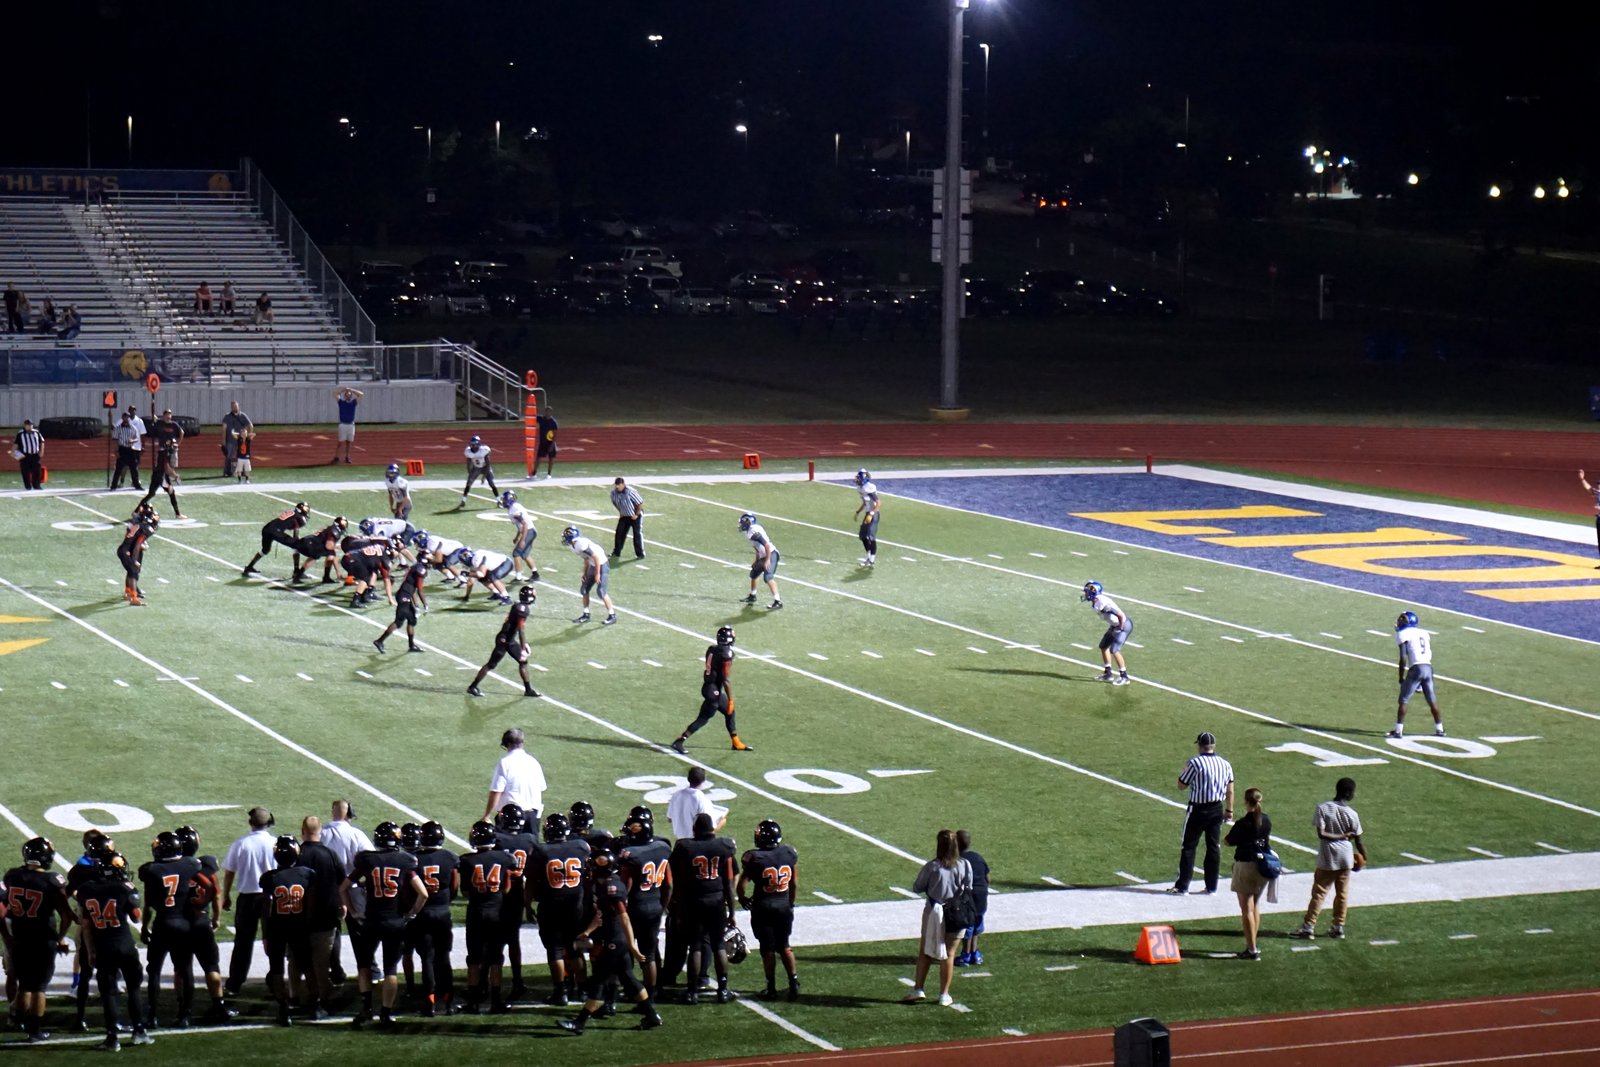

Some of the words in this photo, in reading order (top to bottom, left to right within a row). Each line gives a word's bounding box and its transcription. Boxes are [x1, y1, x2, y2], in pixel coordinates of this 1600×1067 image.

[0, 174, 119, 191] HLETICS
[105, 391, 115, 406] 4
[410, 461, 422, 474] 10
[748, 455, 758, 467] G
[1068, 505, 1600, 602] LIO
[1418, 636, 1427, 655] 9
[1265, 735, 1497, 767] 10
[371, 866, 400, 898] 15
[471, 863, 501, 893] 44
[546, 857, 582, 889] 66
[640, 859, 669, 891] 34
[692, 855, 720, 879] 31
[762, 864, 792, 893] 32
[8, 886, 43, 918] 57
[162, 874, 179, 907] 7
[274, 884, 304, 914] 20
[85, 898, 121, 929] 24
[1148, 930, 1177, 960] 20
